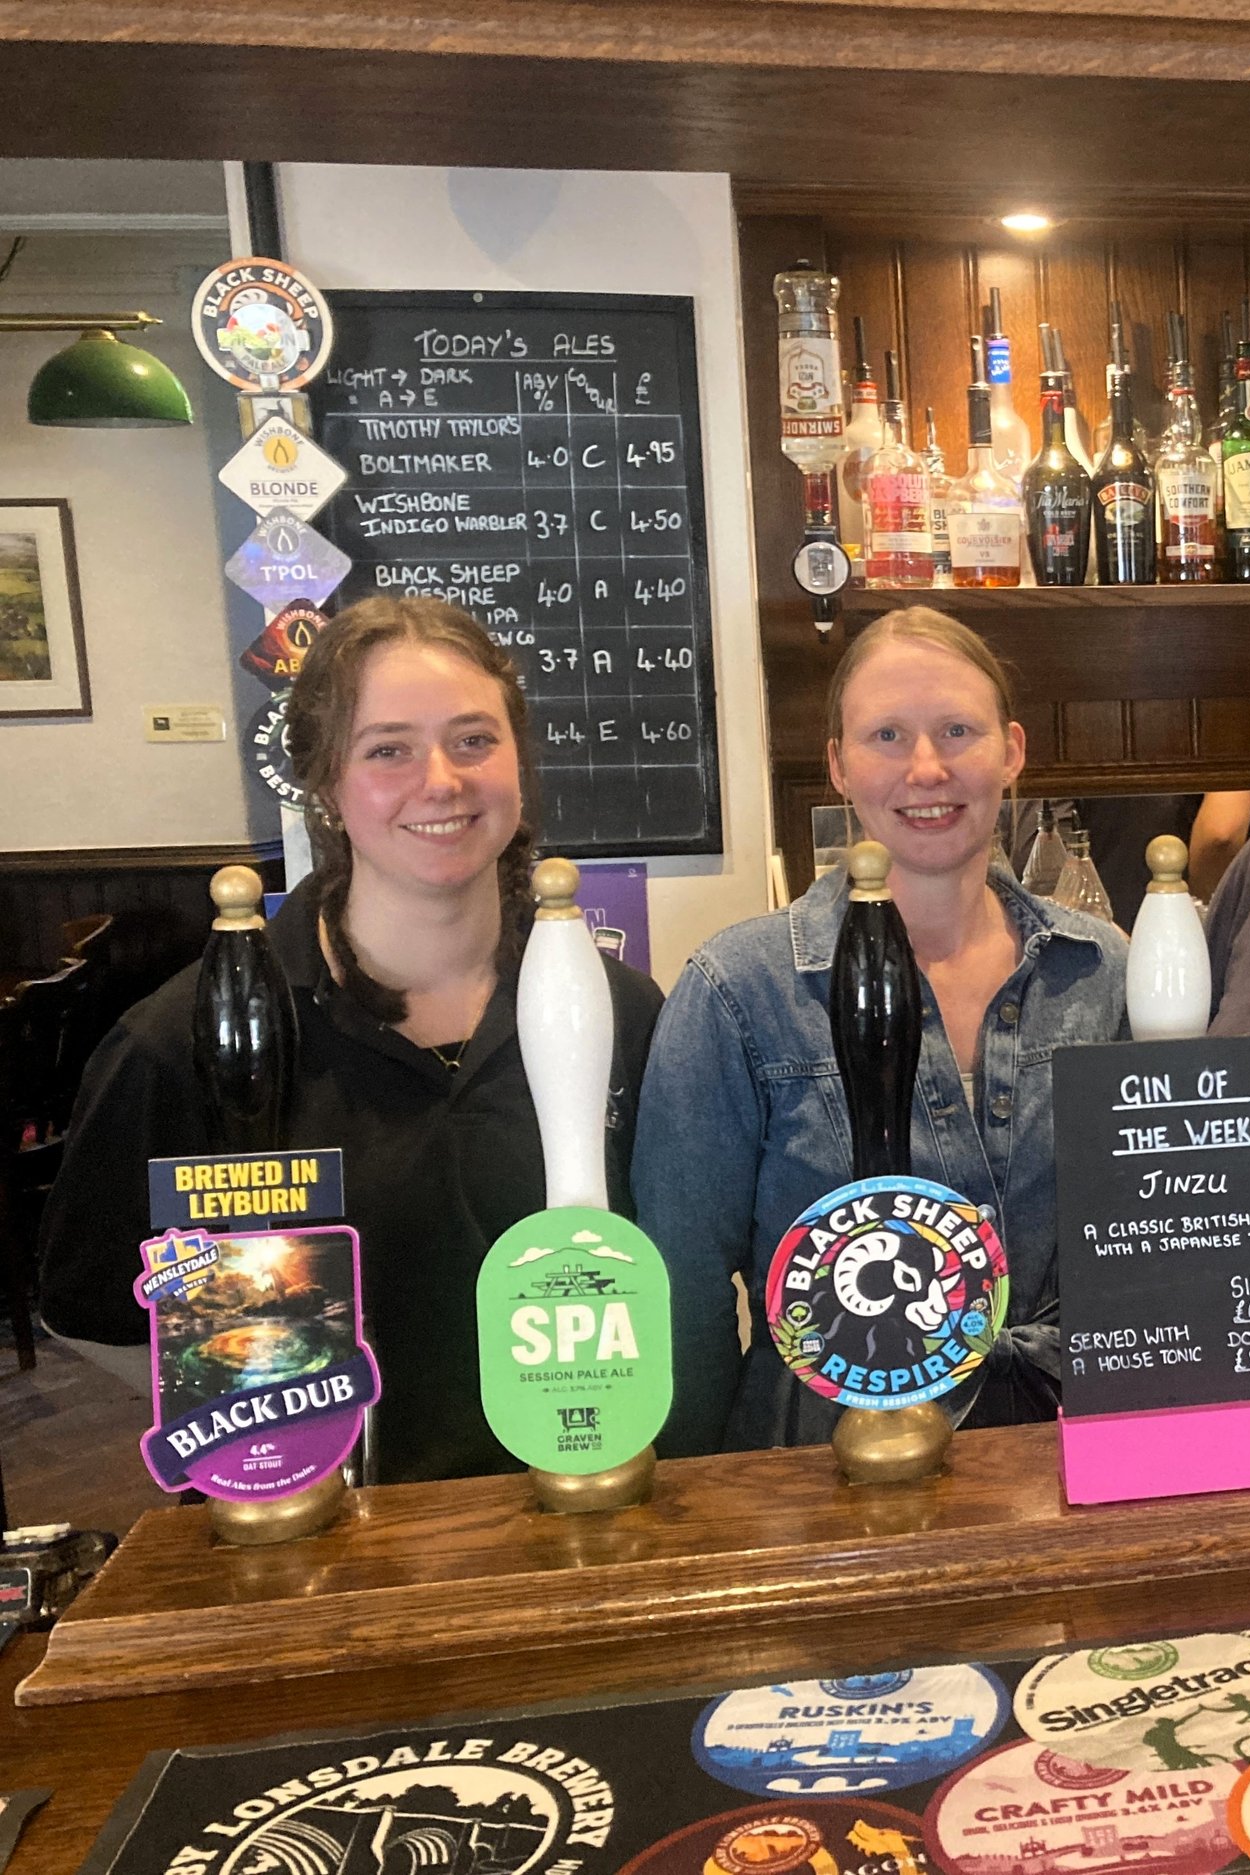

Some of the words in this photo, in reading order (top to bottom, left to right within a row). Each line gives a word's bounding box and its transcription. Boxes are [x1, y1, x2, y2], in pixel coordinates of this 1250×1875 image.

[203, 267, 257, 318] BLACK
[262, 268, 318, 319] SHEEP
[553, 333, 616, 355] ALES
[326, 369, 387, 389] LIGHT
[420, 368, 473, 385] DARK
[523, 374, 558, 391] ABV
[254, 426, 304, 447] WISHBONE
[359, 418, 440, 441] TIMOTHY
[447, 415, 521, 436] TAYLOR'S
[359, 453, 492, 475] BOLTMAKER
[582, 443, 606, 468] C
[250, 482, 318, 495] BLONDE
[1054, 492, 1084, 508] Maria
[1166, 484, 1211, 496] SOUTHERN
[354, 493, 471, 514] WISHBONE
[1169, 497, 1209, 508] COMFORT
[359, 516, 449, 538] INDIGO
[454, 512, 527, 533] WARBLER
[590, 510, 607, 531] C
[260, 564, 318, 581] T'POL
[375, 564, 444, 587] BLACK
[450, 563, 521, 584] SHEEP
[595, 579, 608, 600] A
[487, 608, 519, 625] IPA
[593, 650, 612, 674] A
[598, 720, 619, 742] E
[259, 764, 303, 802] BEST
[1120, 1073, 1172, 1106] GIN
[1197, 1070, 1228, 1099] OF
[1119, 1126, 1170, 1151] THE
[175, 1161, 283, 1191] BREWED
[291, 1158, 318, 1184] IN
[1138, 1170, 1228, 1199] JINZU
[189, 1187, 308, 1219] LEYBURN
[1083, 1223, 1097, 1240] A
[1108, 1219, 1175, 1238] CLASSIC
[1181, 1213, 1250, 1233] BRITISH
[785, 1196, 880, 1292] BLACK
[891, 1194, 988, 1271] SHEEP
[1095, 1243, 1132, 1257] WITH
[1141, 1242, 1151, 1253] A
[1159, 1234, 1242, 1251] JAPANESE
[143, 1248, 217, 1296] WENSLEYDALE
[173, 1277, 208, 1297] BREWERY
[510, 1302, 640, 1366] SPA
[963, 1320, 985, 1328] 4.0%
[1068, 1328, 1137, 1353] SERVED
[1143, 1325, 1190, 1345] WITH
[820, 1338, 969, 1393] RESPIRE
[1072, 1357, 1085, 1376] A
[1098, 1351, 1154, 1373] HOUSE
[1160, 1346, 1202, 1363] TONIC
[519, 1371, 573, 1383] SESSION
[577, 1369, 607, 1381] PALE
[610, 1367, 634, 1378] ALE
[846, 1394, 880, 1408] FRESH
[882, 1392, 927, 1408] SESSION
[929, 1382, 948, 1397] IPA
[167, 1395, 277, 1458] BLACK
[282, 1374, 353, 1416] DUB
[249, 1442, 276, 1456] 4.4%
[557, 1433, 602, 1443] GRAVEN
[557, 1442, 589, 1452] BREW
[242, 1462, 257, 1471] OAT
[259, 1459, 282, 1470] STOUT
[211, 1473, 231, 1488] Real
[231, 1480, 251, 1491] Ales
[253, 1480, 275, 1490] from
[276, 1477, 292, 1488] the
[778, 1701, 935, 1719] RUSKIN'S
[203, 1738, 488, 1838] LONSDALE
[496, 1738, 615, 1848] BREWERY
[974, 1792, 1113, 1823] CRAFTY
[1126, 1780, 1214, 1805] MILD
